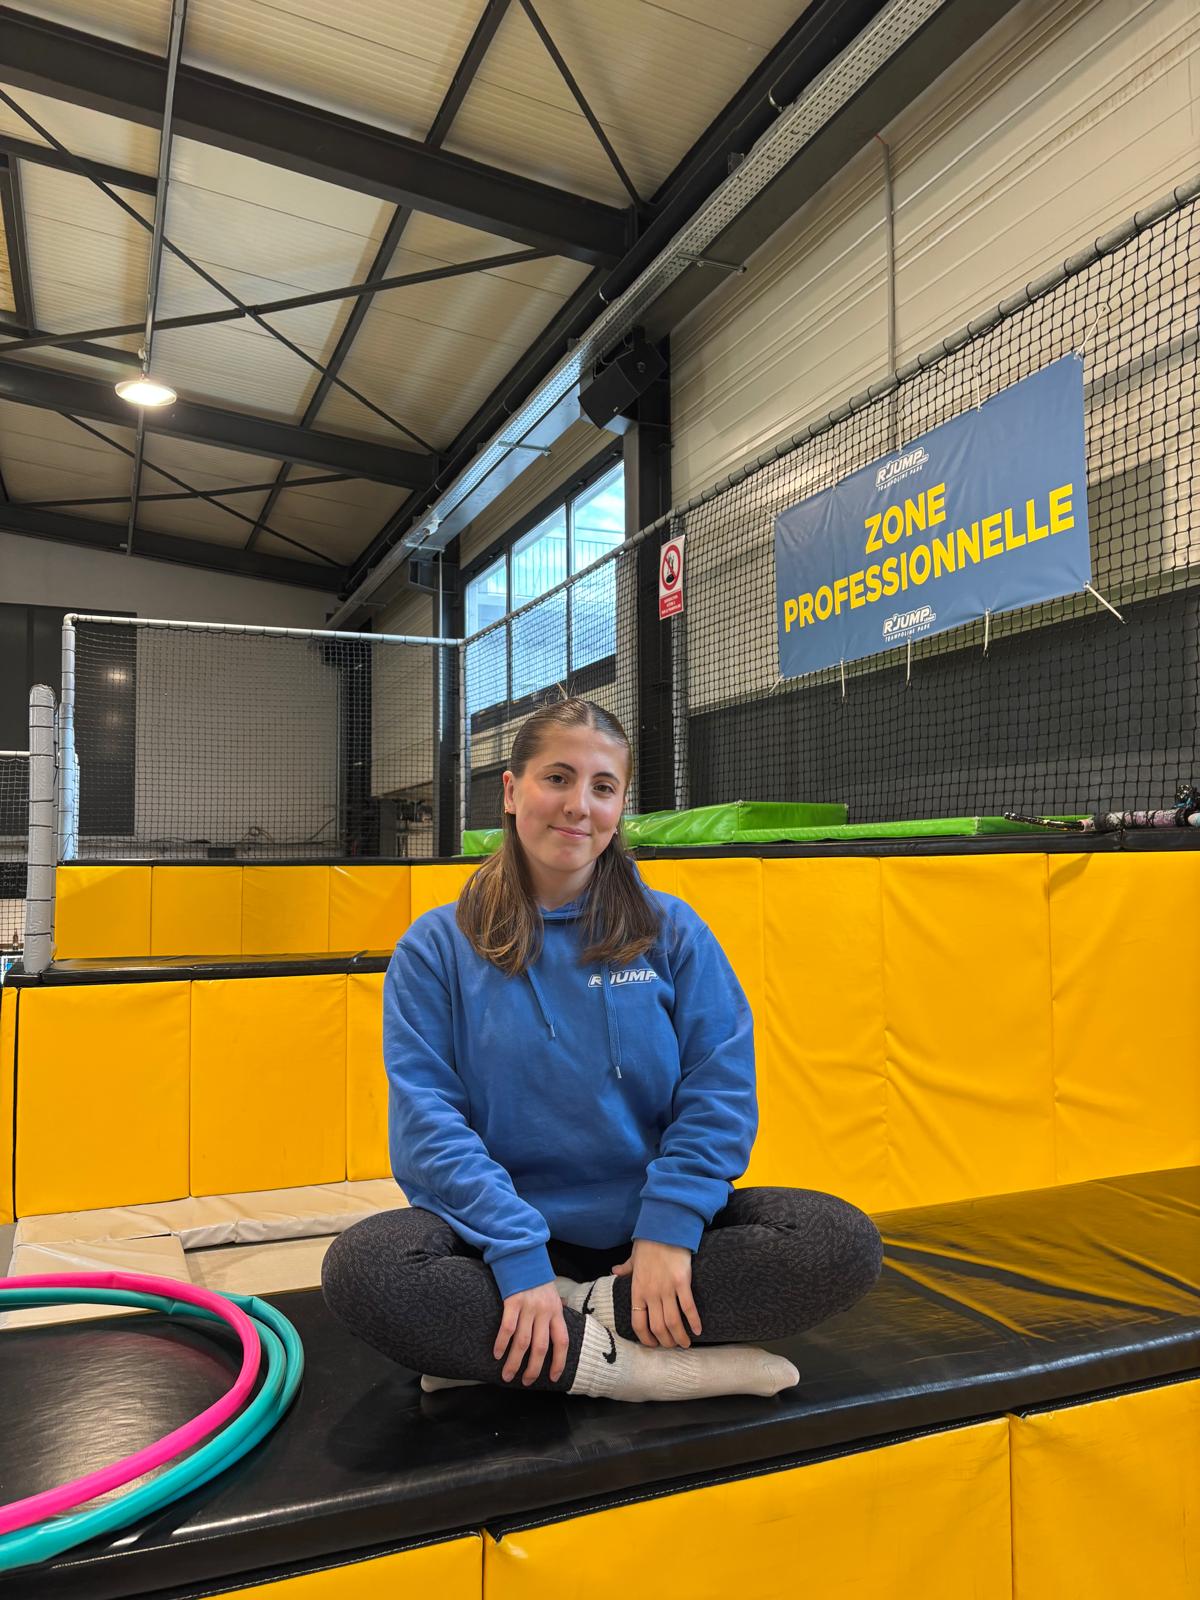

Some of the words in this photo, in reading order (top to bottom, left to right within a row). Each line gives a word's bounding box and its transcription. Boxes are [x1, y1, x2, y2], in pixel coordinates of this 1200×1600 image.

[877, 449, 924, 485] R'JUMP
[864, 482, 947, 555] ZONE
[784, 483, 1075, 632] PROFESSIONNELLE
[883, 607, 930, 635] R'JUMP
[589, 970, 658, 986] RJUMP
